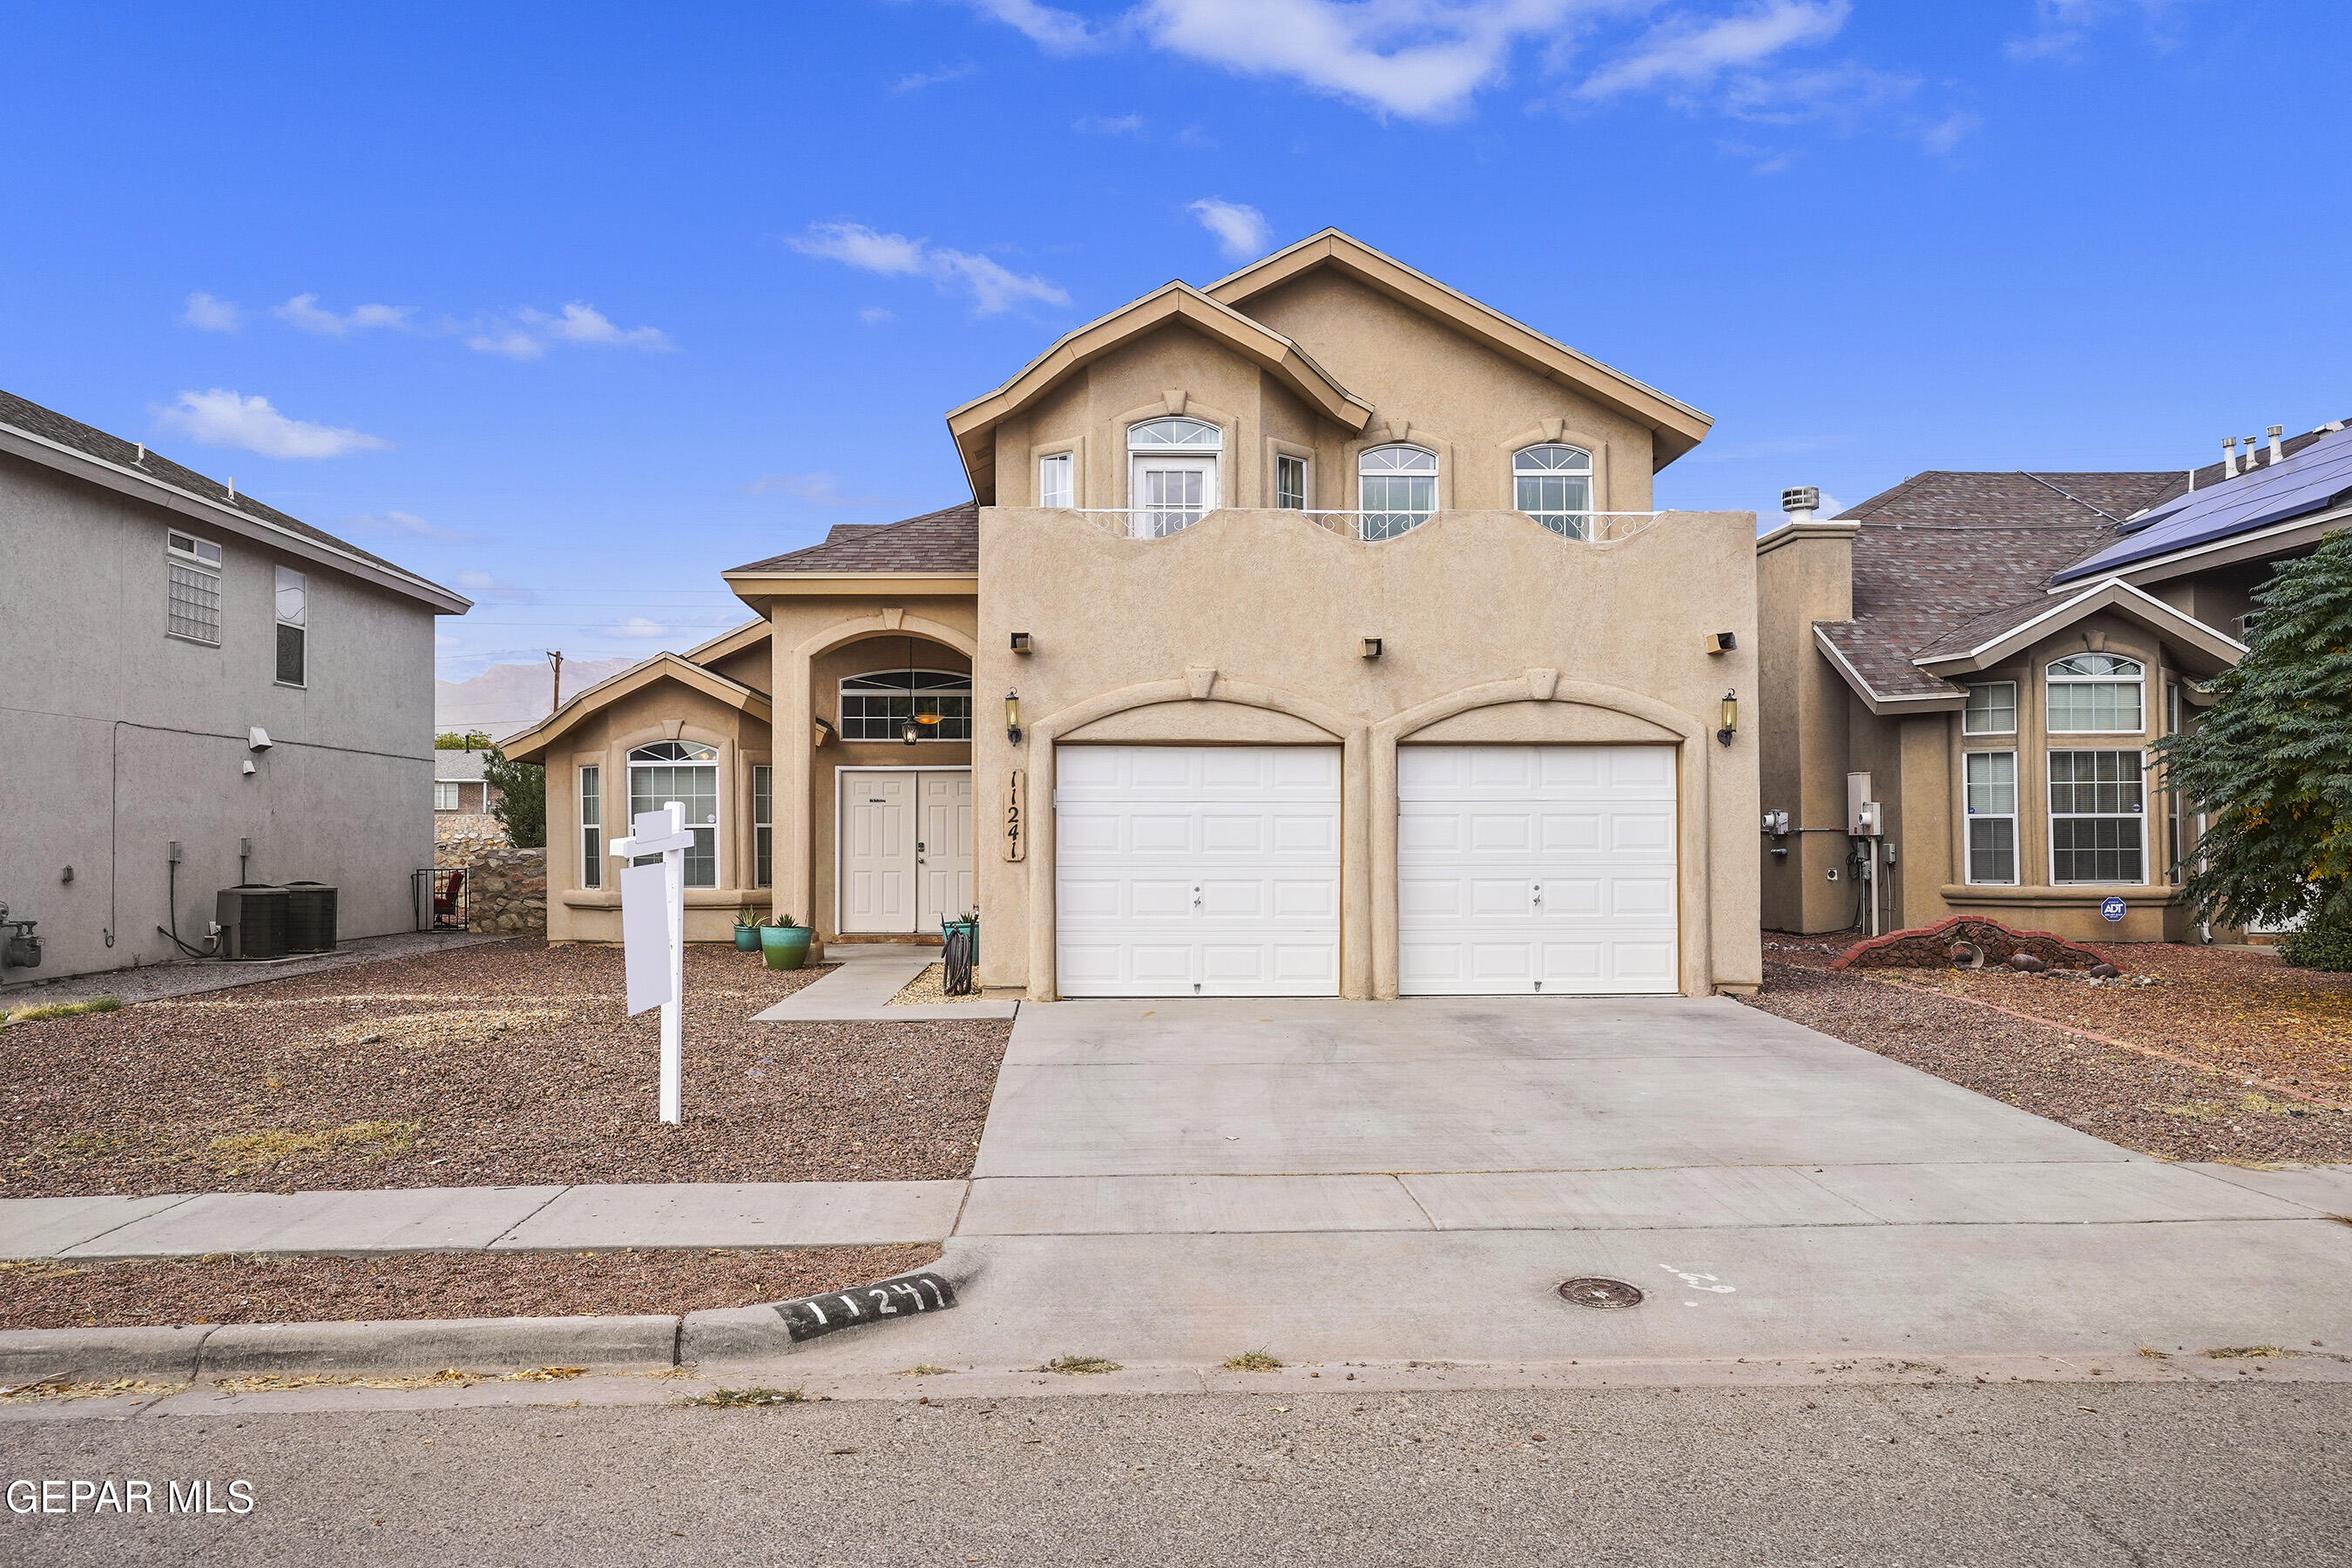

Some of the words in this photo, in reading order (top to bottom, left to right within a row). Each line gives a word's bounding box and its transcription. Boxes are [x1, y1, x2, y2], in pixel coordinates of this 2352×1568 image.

[1007, 770, 1019, 859] 11241
[2104, 903, 2124, 914] ADT
[806, 1278, 946, 1326] 11241
